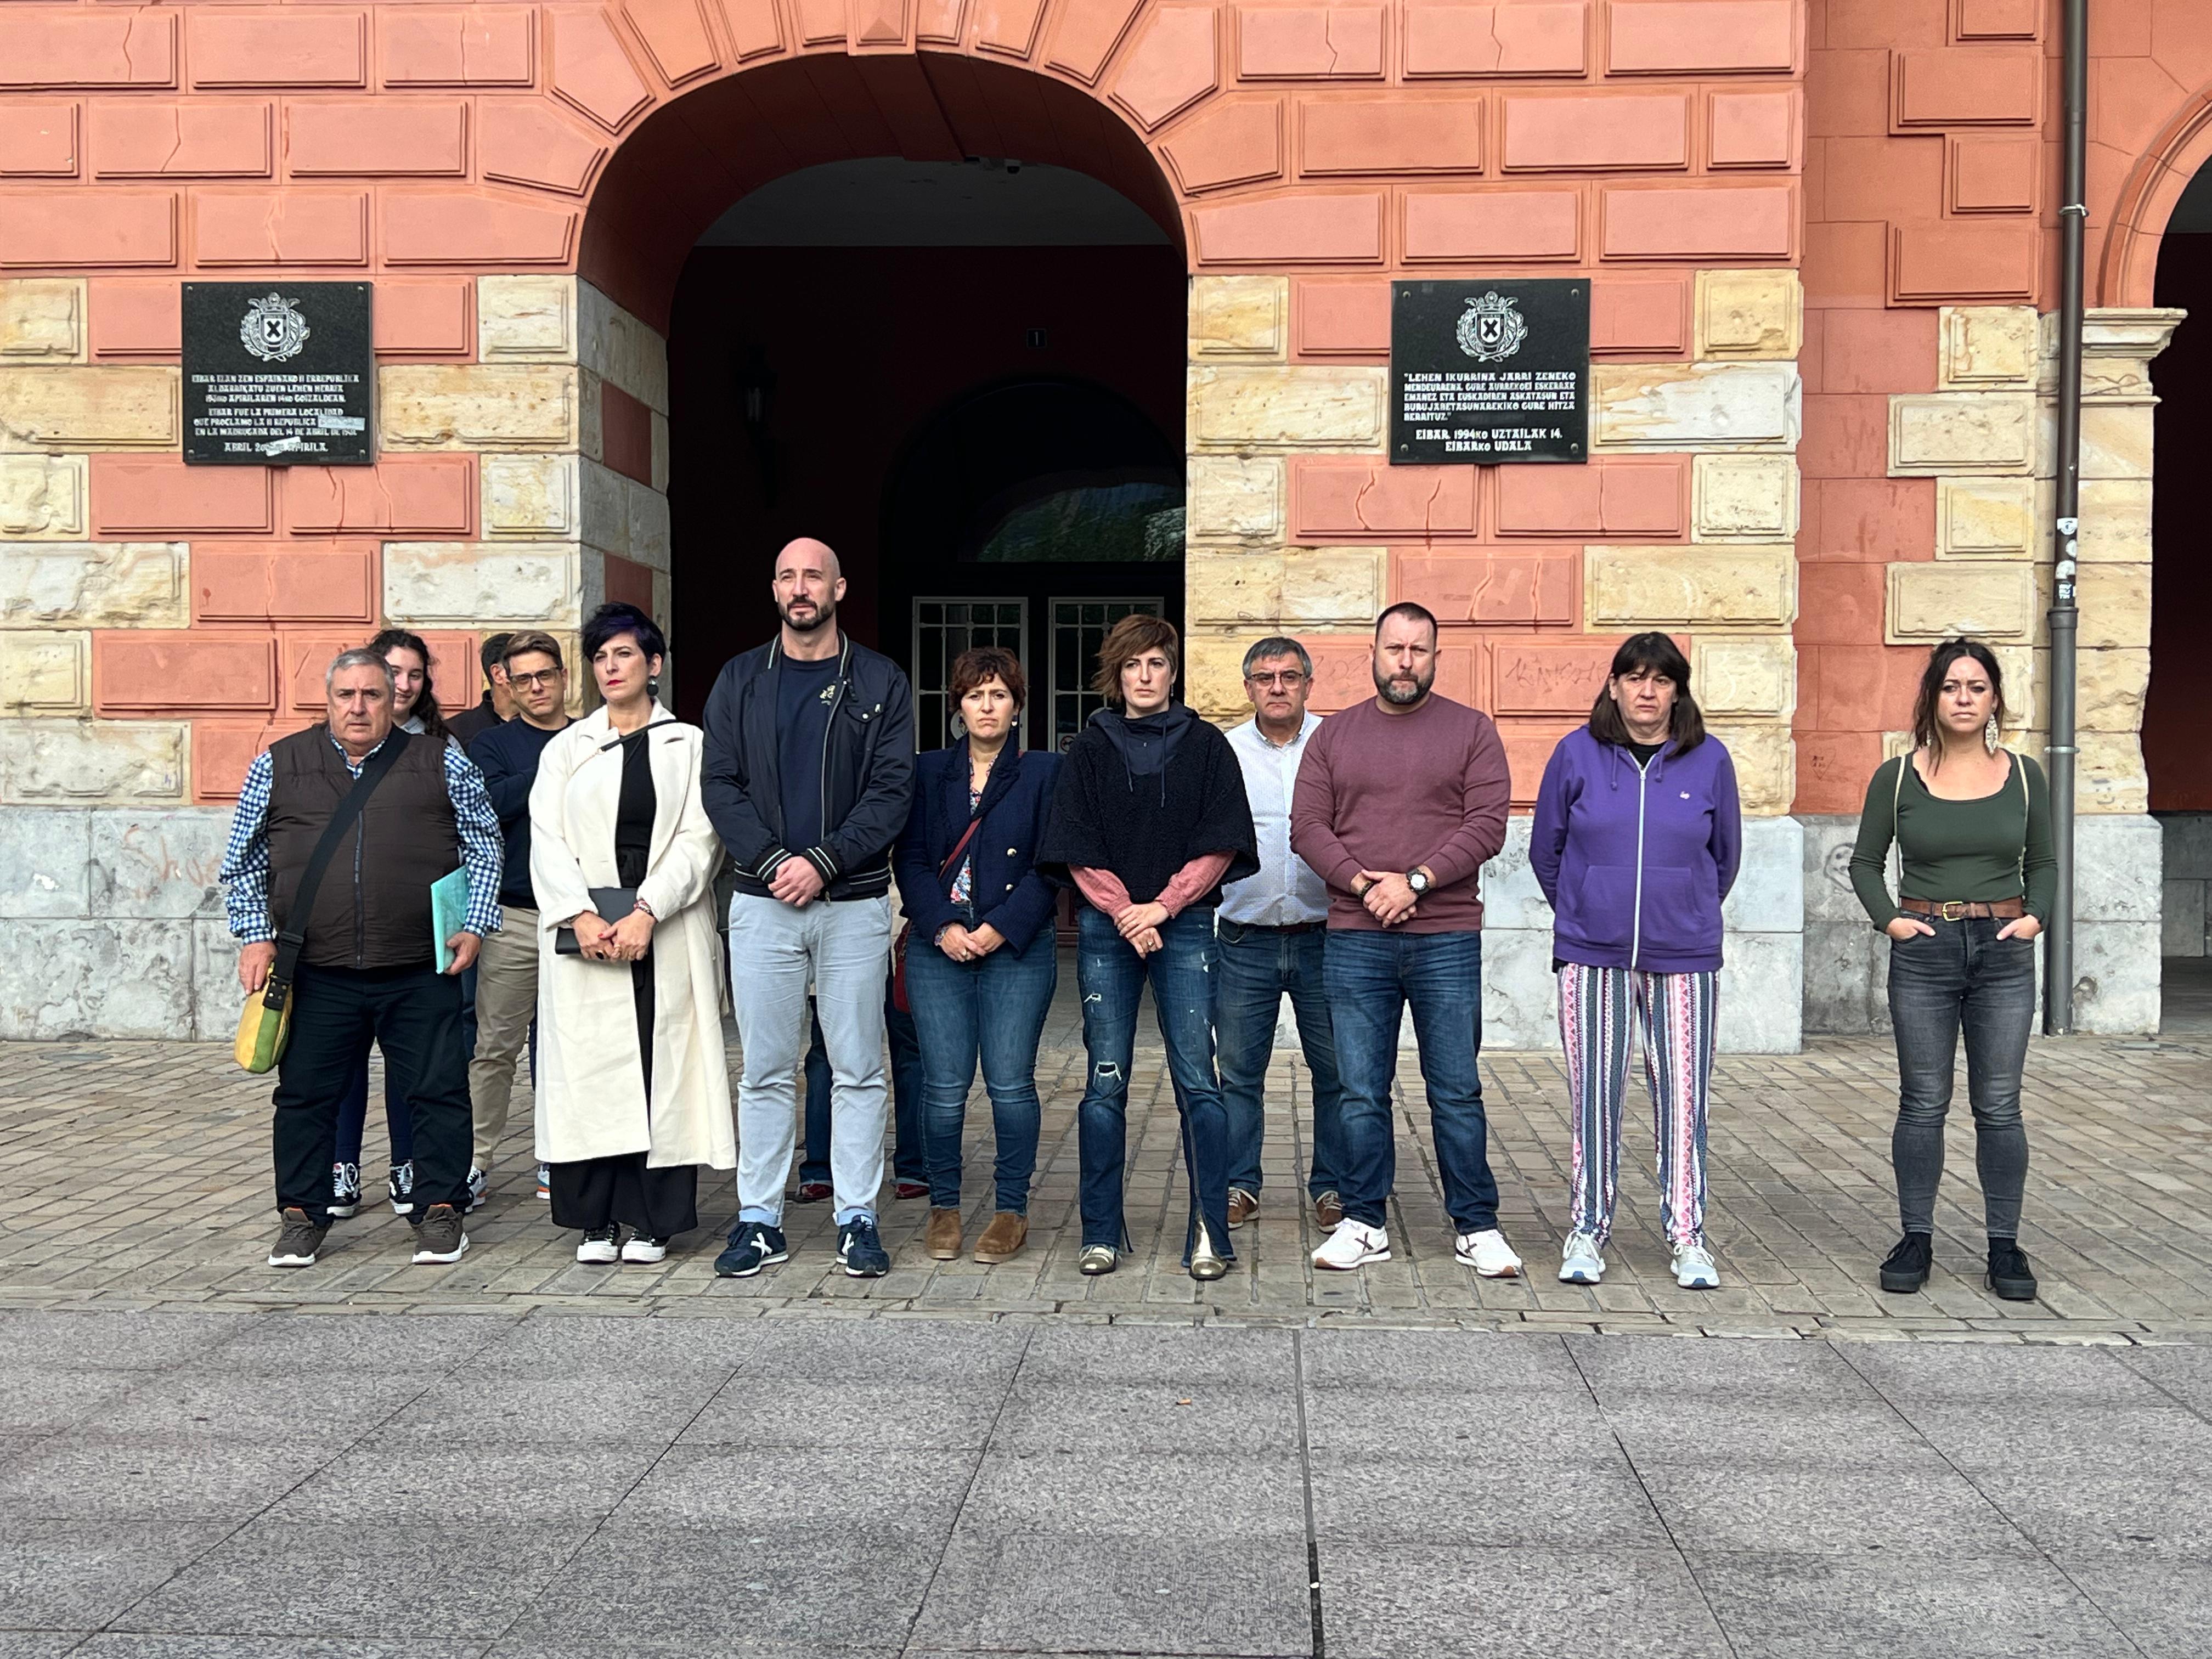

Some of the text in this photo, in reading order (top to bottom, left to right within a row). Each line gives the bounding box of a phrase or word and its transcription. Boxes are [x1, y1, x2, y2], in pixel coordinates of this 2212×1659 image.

[1499, 372, 1532, 381] JARRI
[1535, 371, 1576, 381] ZENEKO
[1465, 382, 1486, 391] GURE
[1534, 381, 1576, 390] ESKERRAK
[1404, 392, 1575, 401] EMANEZ ETA EUSKADIREN ASKATASUN ETA
[1521, 402, 1545, 410] GURE
[1548, 402, 1575, 410] HITZA
[234, 408, 249, 416] FUE
[250, 408, 262, 416] LA
[1491, 428, 1547, 439] UZTAILAK
[224, 442, 252, 452] ABRIL
[1494, 441, 1532, 451] UDALA
